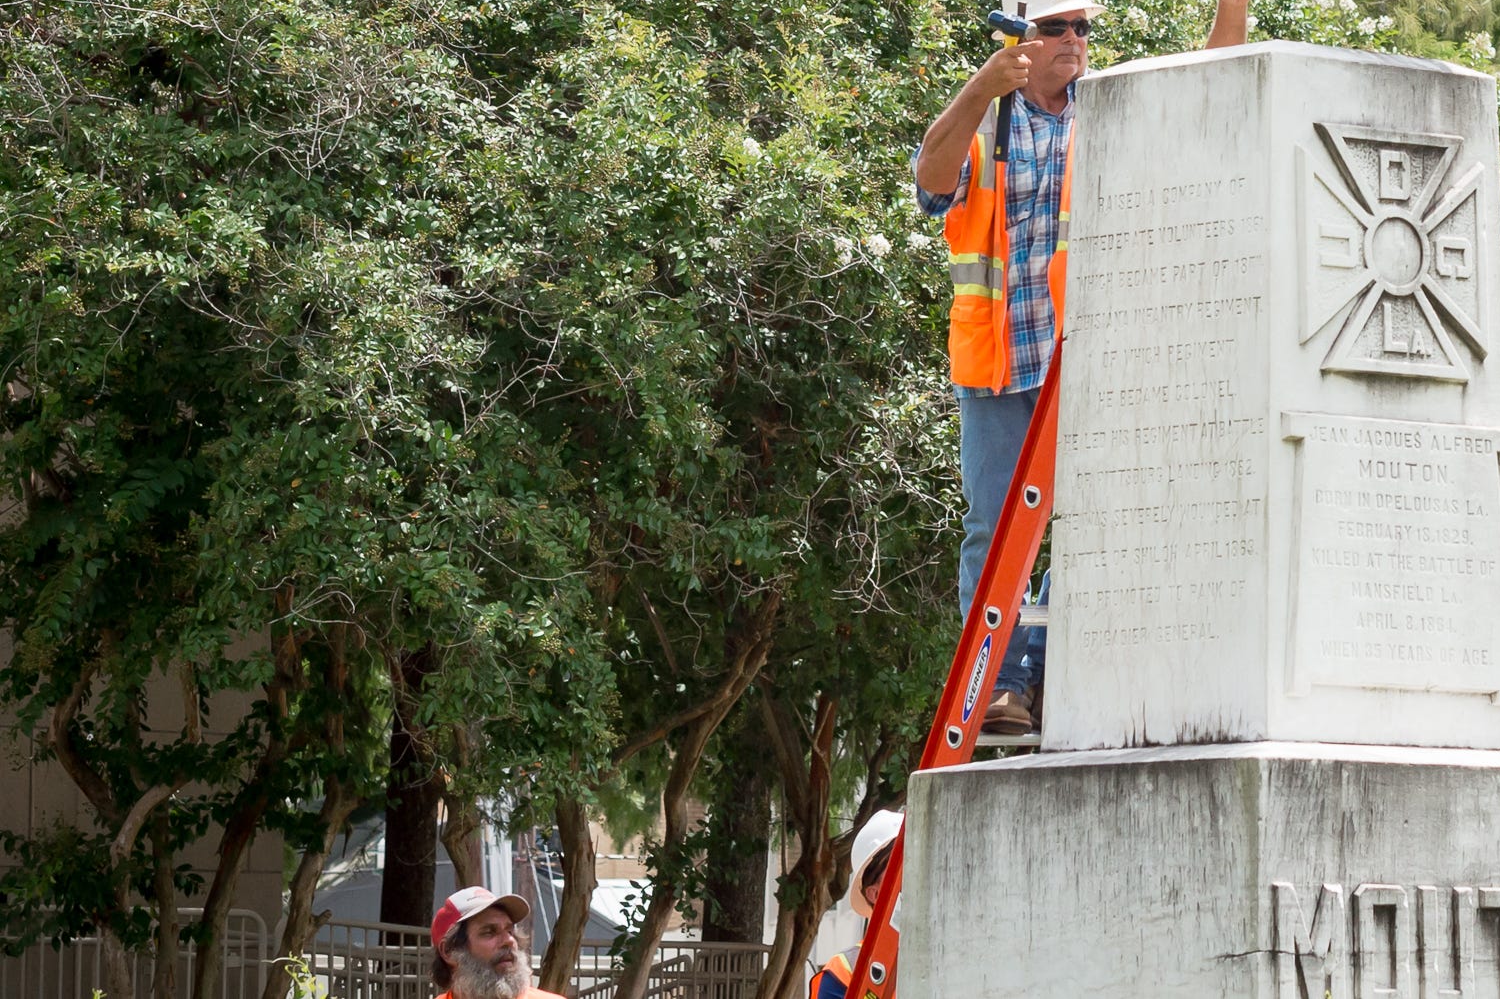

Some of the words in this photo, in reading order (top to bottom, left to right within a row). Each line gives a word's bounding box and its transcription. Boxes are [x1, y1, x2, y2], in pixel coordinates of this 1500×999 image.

[1310, 426, 1348, 443] JEAN
[1353, 429, 1422, 449] JACQUES
[1430, 434, 1493, 454] ALFRED
[1314, 489, 1352, 507] BORN
[1358, 491, 1371, 507] IN
[1376, 493, 1459, 515] OPELOUSAS
[1337, 521, 1413, 541] FEBRUARY
[1312, 547, 1359, 567] KILLED
[1366, 552, 1383, 569] AT
[1387, 553, 1414, 572] THE
[1419, 556, 1473, 575] BATTLE
[1479, 560, 1496, 577] OF
[1351, 581, 1433, 603] MANSFIELD
[1356, 611, 1398, 630] APRIL
[1320, 640, 1359, 659] WHEN
[1365, 643, 1382, 659] 35
[1388, 643, 1433, 662] YEARS
[1440, 647, 1455, 663] OF
[968, 651, 987, 704] WERNER
